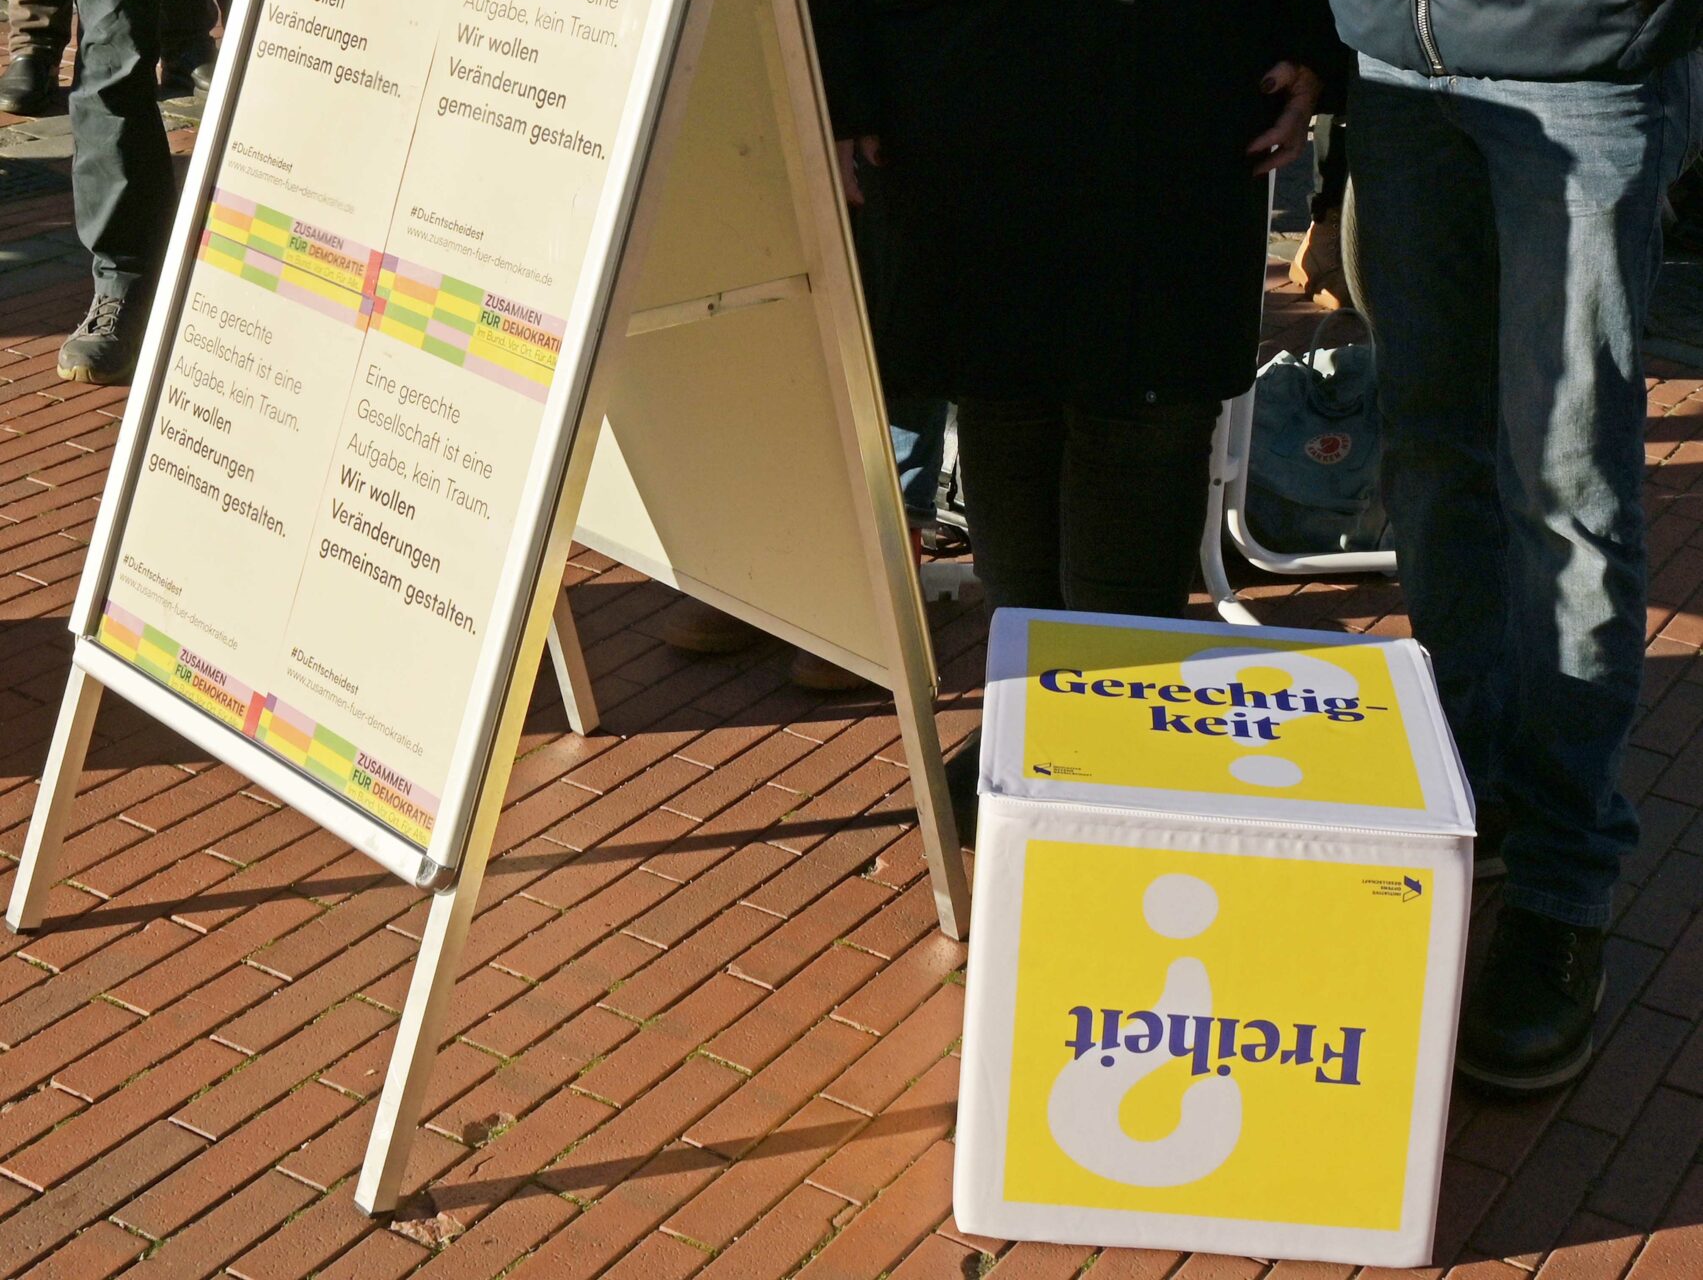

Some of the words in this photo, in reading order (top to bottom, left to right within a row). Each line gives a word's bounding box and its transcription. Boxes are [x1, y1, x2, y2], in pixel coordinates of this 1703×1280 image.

[268, 3, 368, 51] Veränderungen
[457, 22, 484, 47] Wir
[489, 37, 539, 63] wollen
[534, 7, 565, 33] kein
[570, 15, 618, 48] Traum.
[256, 39, 333, 75] gemeinsam
[334, 64, 401, 98] gestalten.
[449, 56, 567, 110] Veränderungen
[437, 96, 528, 135] gemeinsam
[529, 124, 605, 160] gestalten.
[231, 140, 293, 173] #DuEntscheidest
[293, 221, 344, 251] ZUSAMMEN
[411, 205, 484, 241] #DuEntscheidest
[289, 235, 308, 252] FÜR
[308, 243, 364, 276] DEMOKRATIE
[407, 226, 553, 286] www.zusammen-fuer-demokratie.de
[192, 291, 218, 319] Eine
[219, 310, 273, 345] gerechte
[481, 310, 501, 328] FÜR
[502, 318, 562, 352] DEMOKRATI
[485, 294, 542, 326] ZUSAMMEN
[184, 323, 254, 373] Gesellschaft
[256, 358, 272, 381] ist
[274, 369, 302, 395] eine
[168, 384, 191, 412] Wir
[193, 403, 232, 434] wollen
[229, 381, 255, 409] kein
[259, 394, 299, 432] Traum.
[366, 364, 396, 394] Eine
[398, 385, 461, 424] gerechte
[160, 416, 255, 483] Veränderungen
[357, 398, 441, 453] Gesellschaft
[443, 438, 460, 463] ist
[462, 451, 493, 479] eine
[148, 453, 220, 501] gemeinsam
[222, 492, 286, 538] gestalten.
[340, 464, 366, 494] Wir
[369, 484, 416, 521] wollen
[347, 433, 407, 480] Aufgabe,
[412, 462, 441, 494] kein
[445, 478, 490, 520] Traum.
[332, 497, 441, 574] Veränderungen
[123, 554, 183, 597] #DuEntscheidest
[319, 538, 403, 593] gemeinsam
[404, 584, 476, 635] gestalten.
[175, 664, 192, 683] FÜR
[192, 675, 245, 716] DEMOKRATIE
[180, 648, 228, 687] ZUSAMMEN
[290, 646, 359, 696] #DuEntscheidest
[286, 667, 424, 757] www.zusammen-fuer-demokratie.de
[1039, 668, 1388, 722] Gerechtig-
[1150, 706, 1281, 741] keit
[352, 770, 372, 791] FÜR
[373, 782, 434, 830] DEMOKRATIE
[357, 752, 413, 796] ZUSAMMEN
[1064, 1005, 1367, 1086] Freiheit
